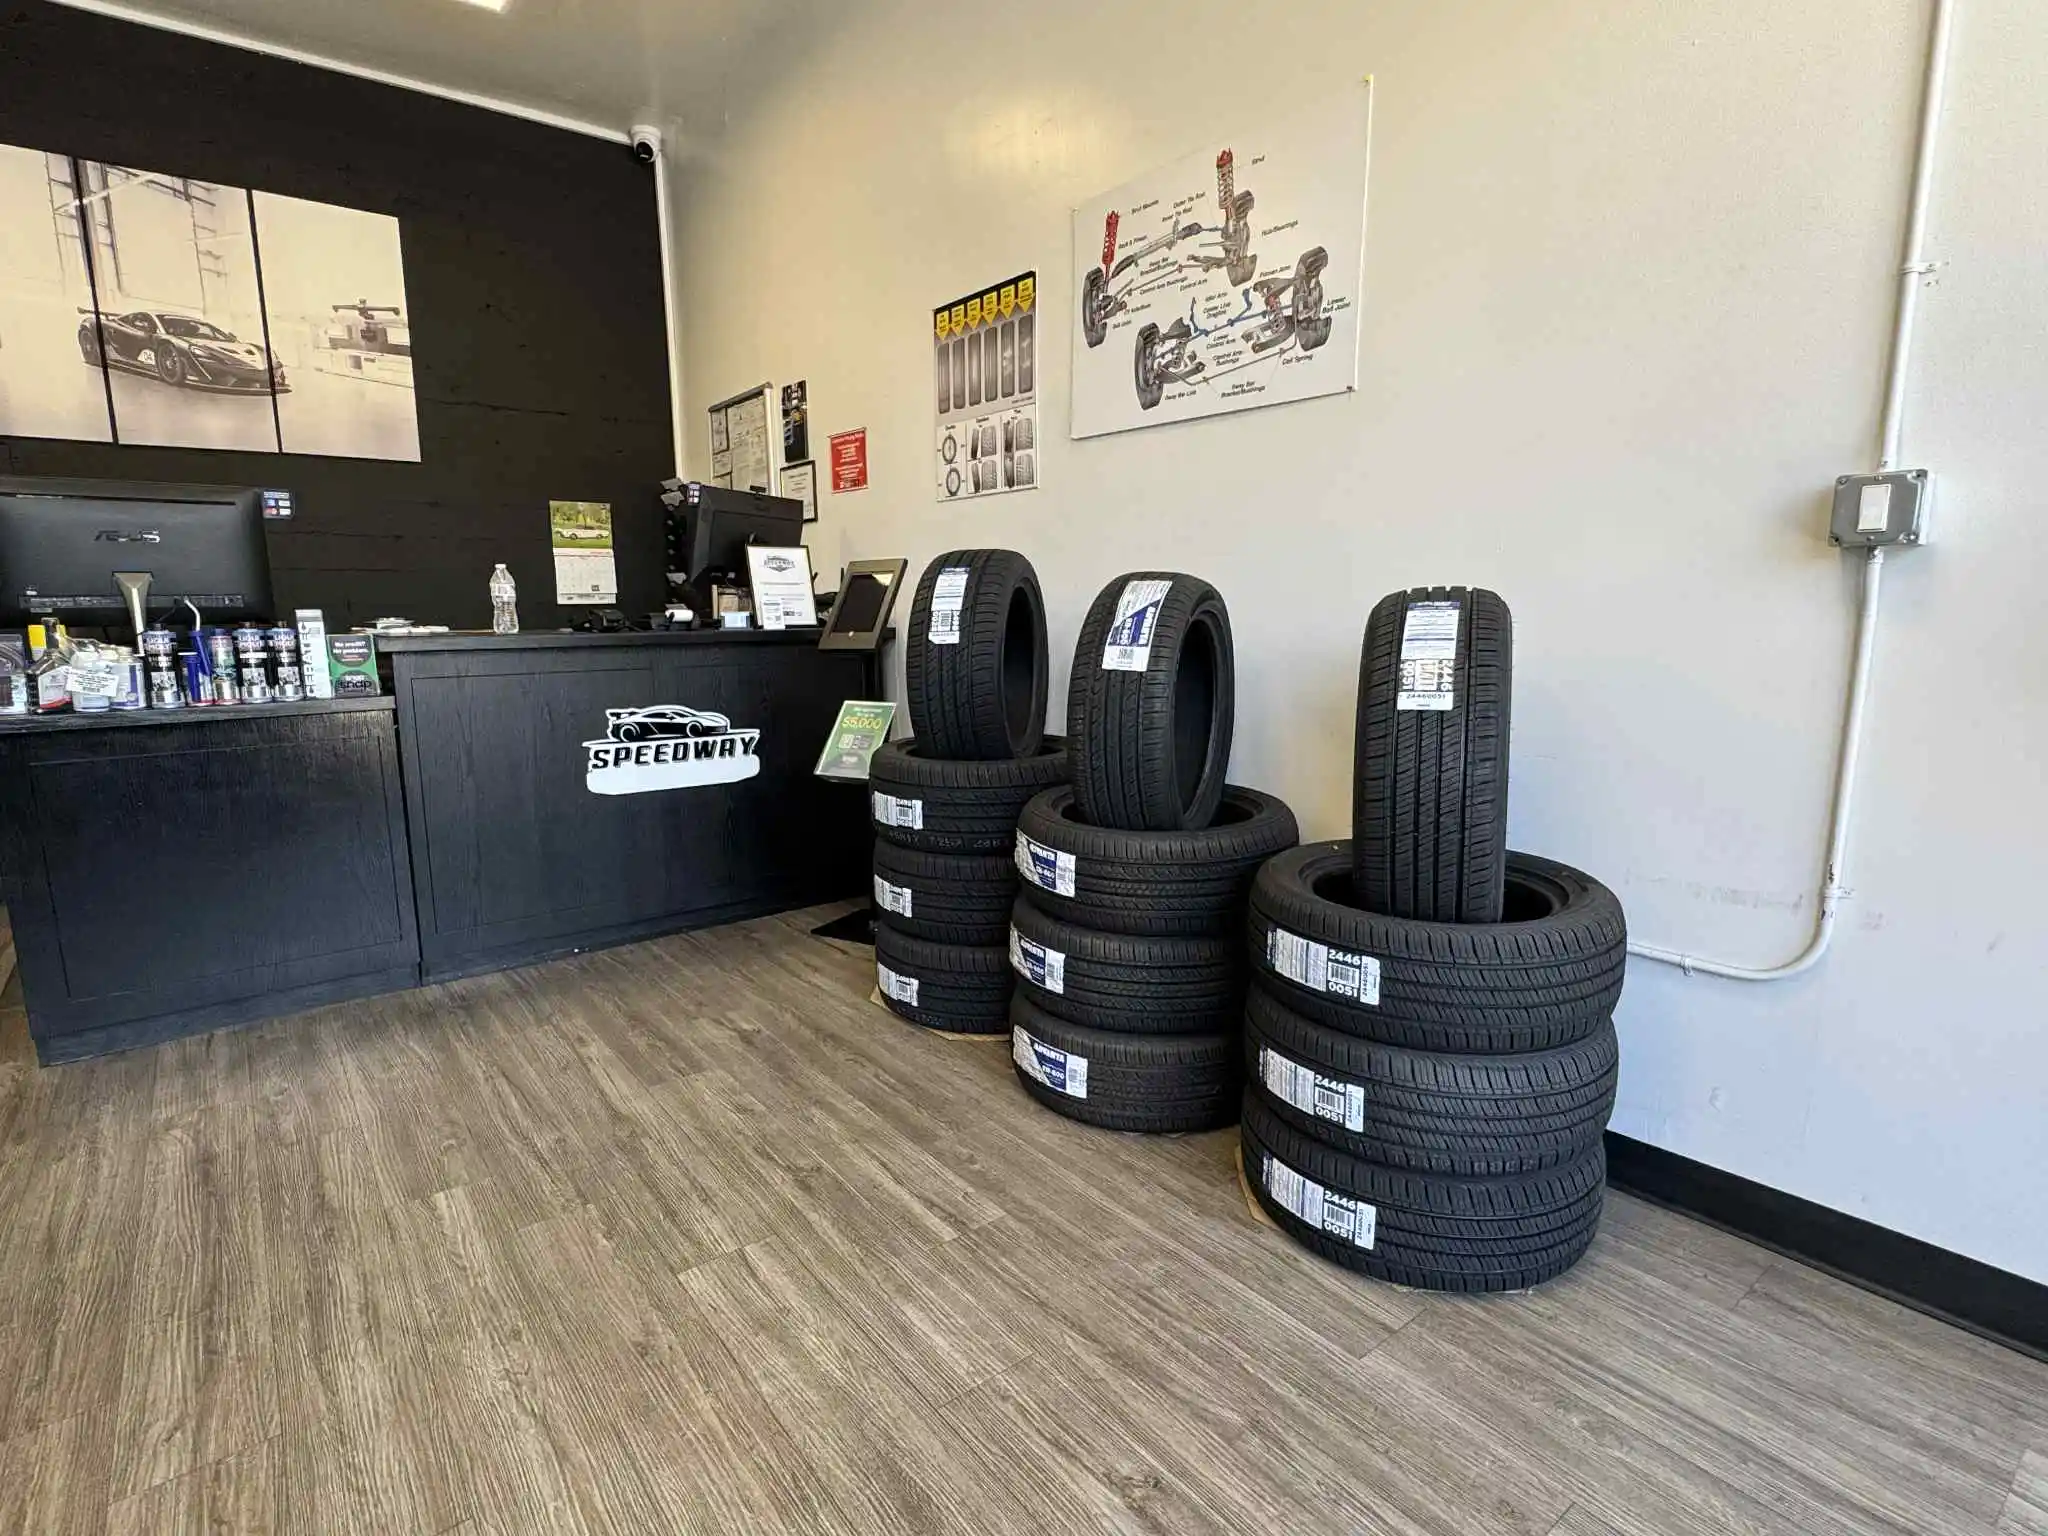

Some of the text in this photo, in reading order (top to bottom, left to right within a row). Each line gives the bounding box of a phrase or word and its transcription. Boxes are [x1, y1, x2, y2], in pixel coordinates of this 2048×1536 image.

[94, 528, 160, 543] ASUS
[591, 735, 757, 770] SPEEDWAY
[1328, 949, 1361, 966] 2446
[1328, 982, 1359, 997] 0051
[1315, 1074, 1346, 1093] 2446
[1315, 1106, 1344, 1123] 0051
[1324, 1190, 1356, 1210] 2446
[1324, 1221, 1353, 1240] 0051
